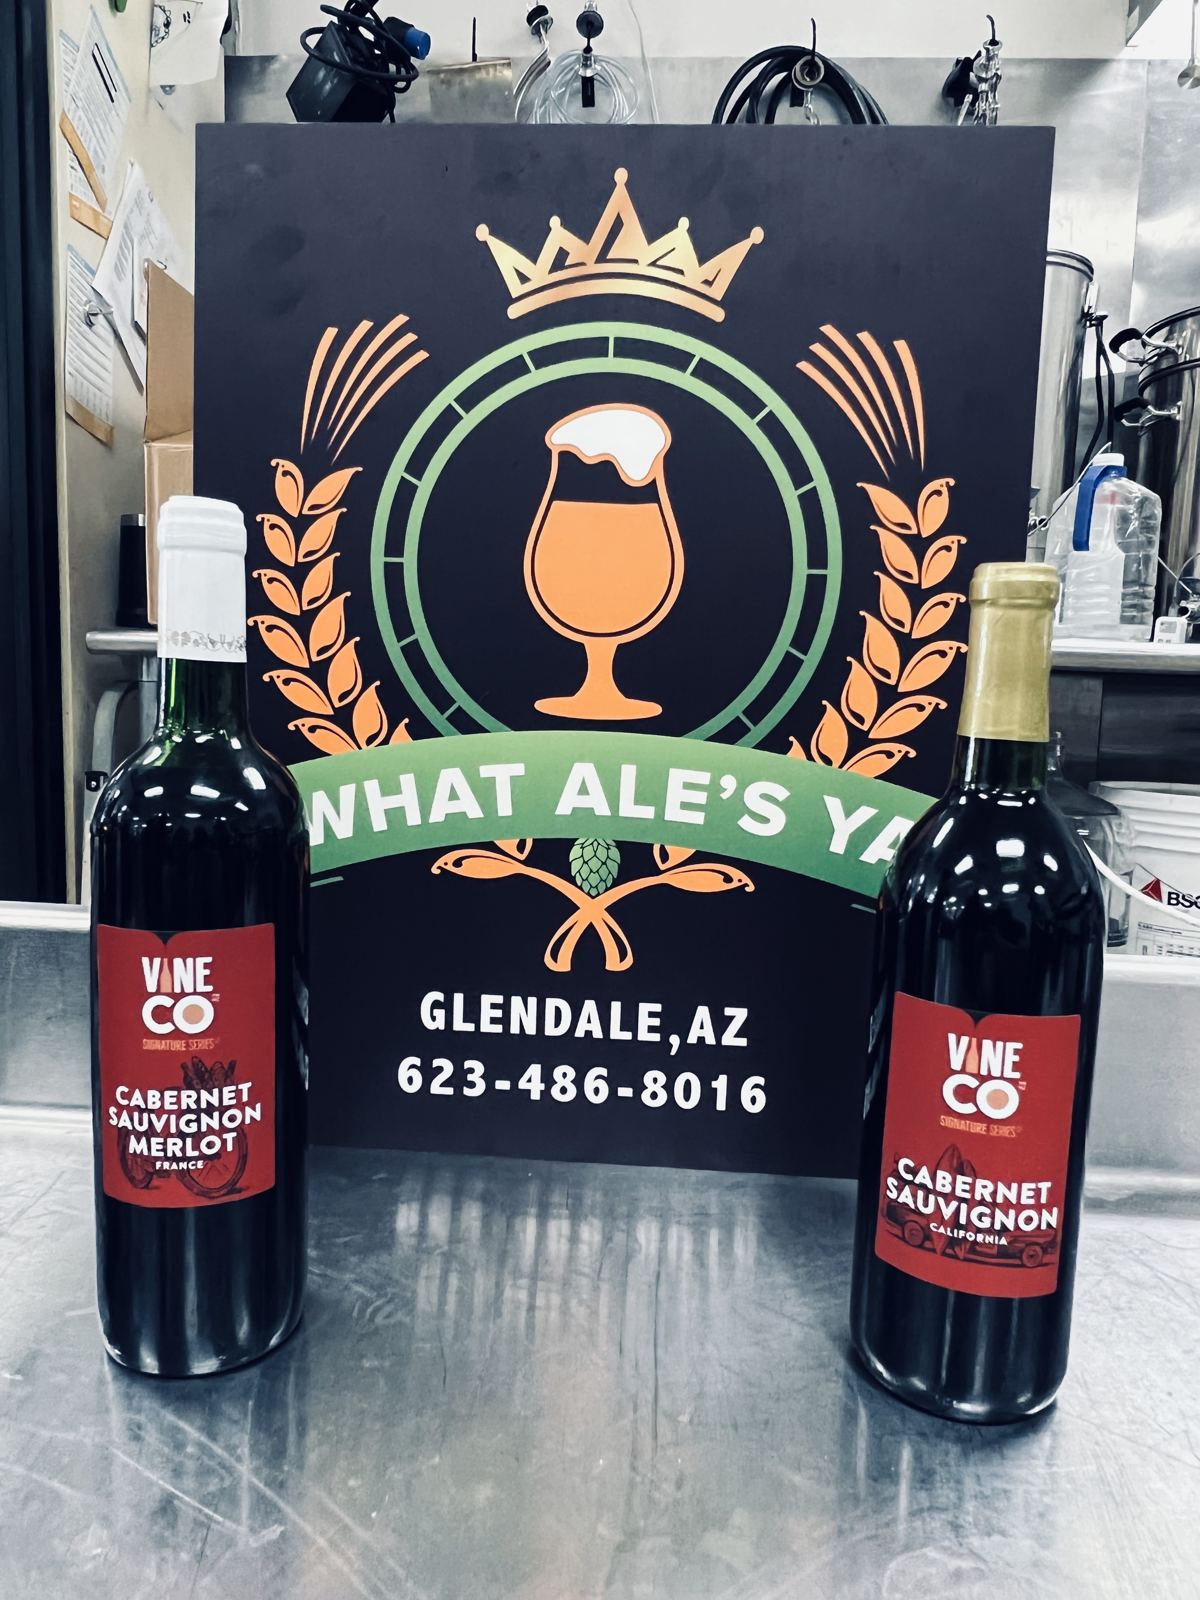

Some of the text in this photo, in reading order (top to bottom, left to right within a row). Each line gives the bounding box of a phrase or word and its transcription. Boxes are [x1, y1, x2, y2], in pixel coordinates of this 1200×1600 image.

[309, 762, 525, 846] WHAT
[554, 762, 791, 837] ALE'S
[141, 956, 214, 994] VINE
[141, 994, 215, 1035] CO
[142, 1038, 215, 1050] SIGNATURE SERIES
[947, 1032, 1024, 1079] VINE
[115, 1082, 252, 1110] CABERNET
[397, 1056, 767, 1114] 623-486-8016
[942, 1073, 1020, 1120] CO
[108, 1103, 262, 1134] SAUVIGNON
[940, 1115, 1017, 1138] SIGNATURE SERIES
[128, 1132, 237, 1157] MERLOT
[155, 1160, 204, 1170] FRANCE
[897, 1157, 1052, 1205] CABERNET
[886, 1177, 1059, 1232] SAUVIGNON
[929, 1222, 1008, 1246] CALIFORNIA
